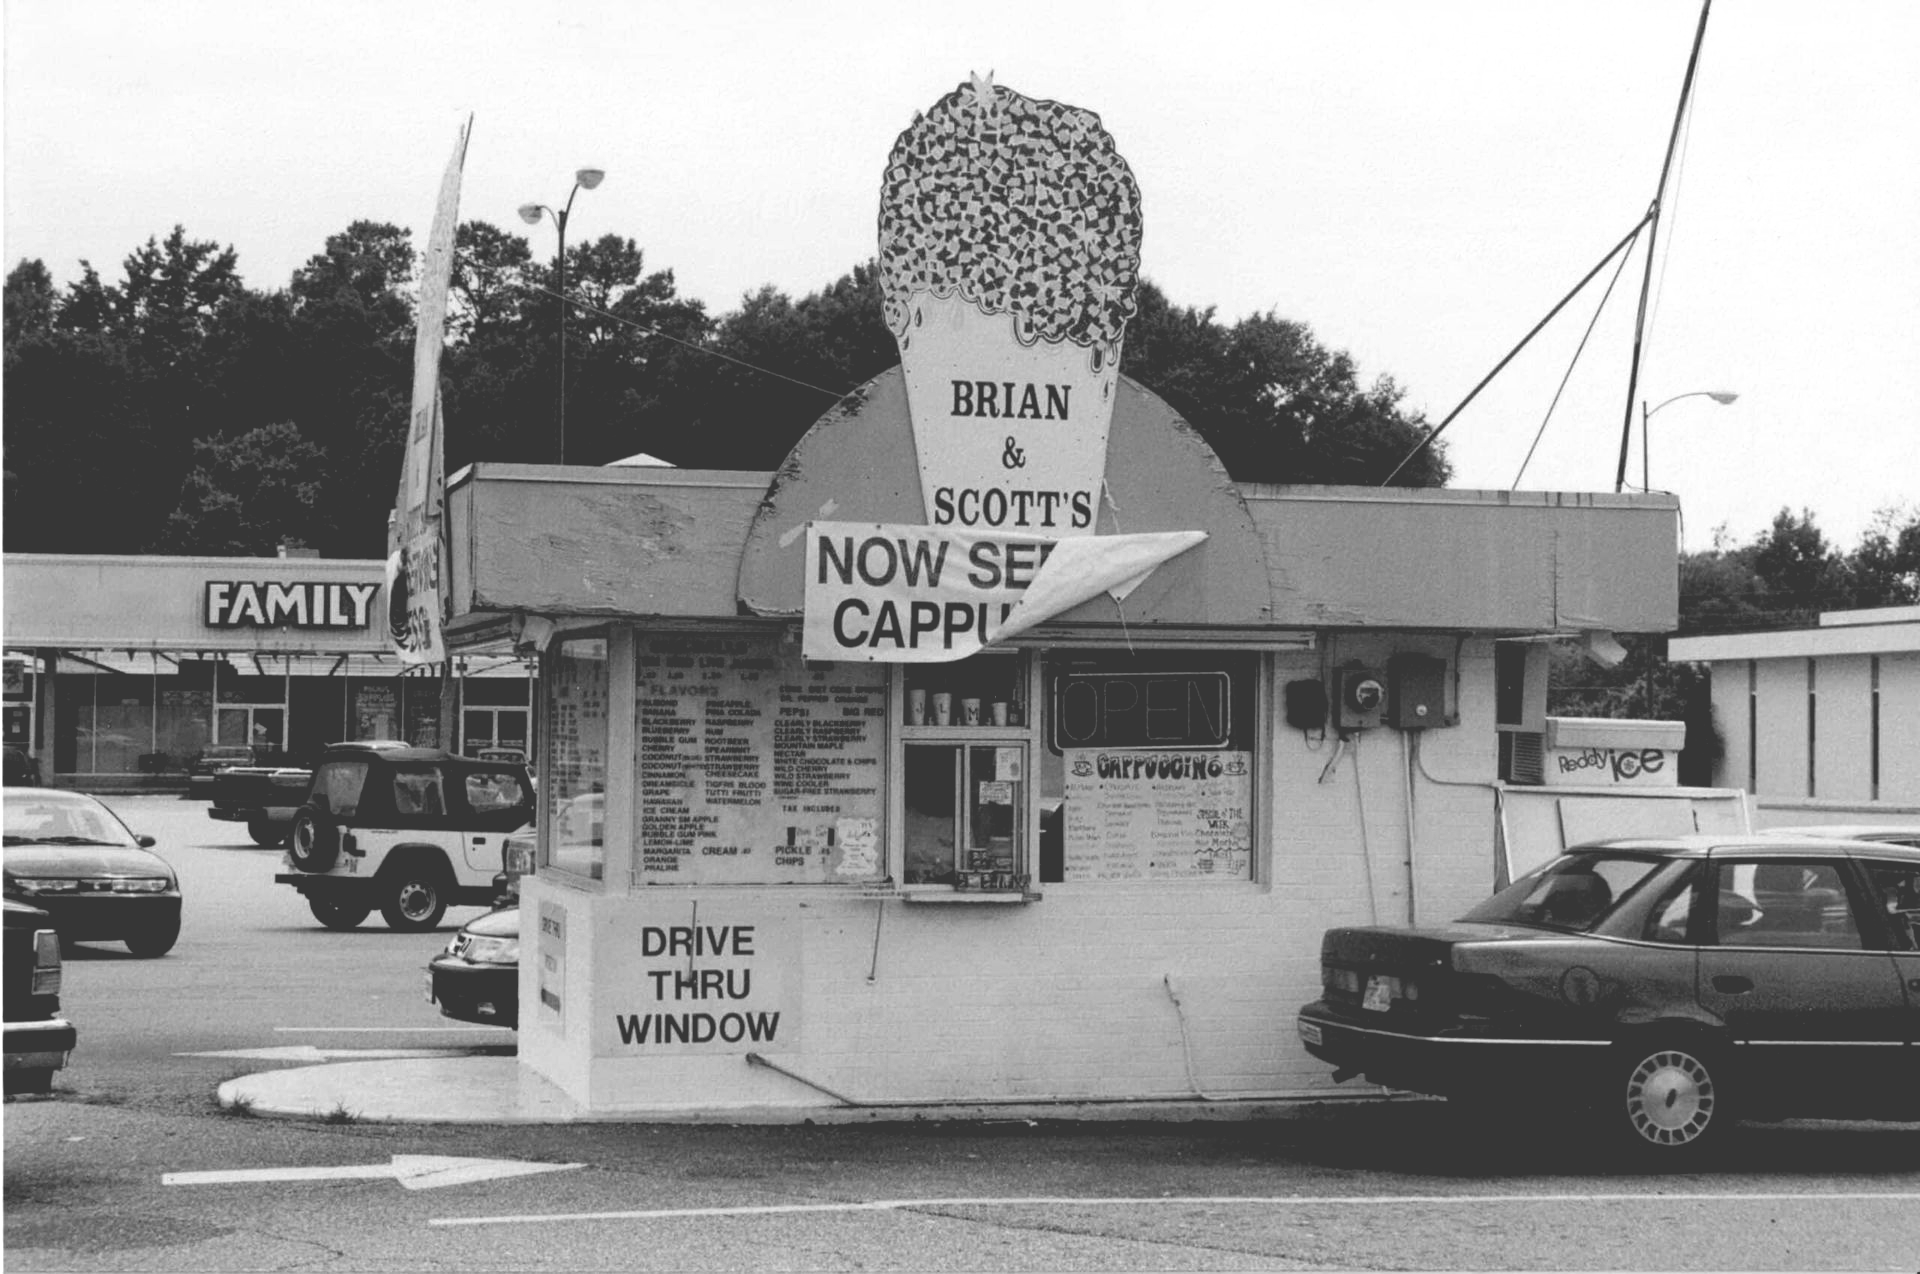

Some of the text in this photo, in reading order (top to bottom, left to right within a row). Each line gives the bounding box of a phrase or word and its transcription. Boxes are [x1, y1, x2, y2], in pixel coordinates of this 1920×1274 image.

[951, 380, 1071, 420] BRIAN
[1002, 436, 1026, 469] &
[934, 487, 1091, 528] SCOTT'S
[818, 536, 949, 587] NOW
[208, 584, 375, 625] FAMILY
[780, 708, 884, 716] PEPSI BIG RED
[940, 703, 947, 713] L
[968, 707, 979, 720] M
[1062, 679, 1222, 741] OPEN
[1558, 748, 1608, 774] Reddy
[705, 798, 761, 806] WATERMELON
[732, 789, 761, 797] FRUTTI
[803, 805, 840, 813] INCLUDED
[702, 847, 738, 855] CREAM
[775, 846, 812, 855] PICKLE
[775, 857, 804, 866] CHIPS
[642, 926, 754, 956] DRIVE
[648, 969, 750, 1000] THRU
[616, 1012, 780, 1044] WINDOW
